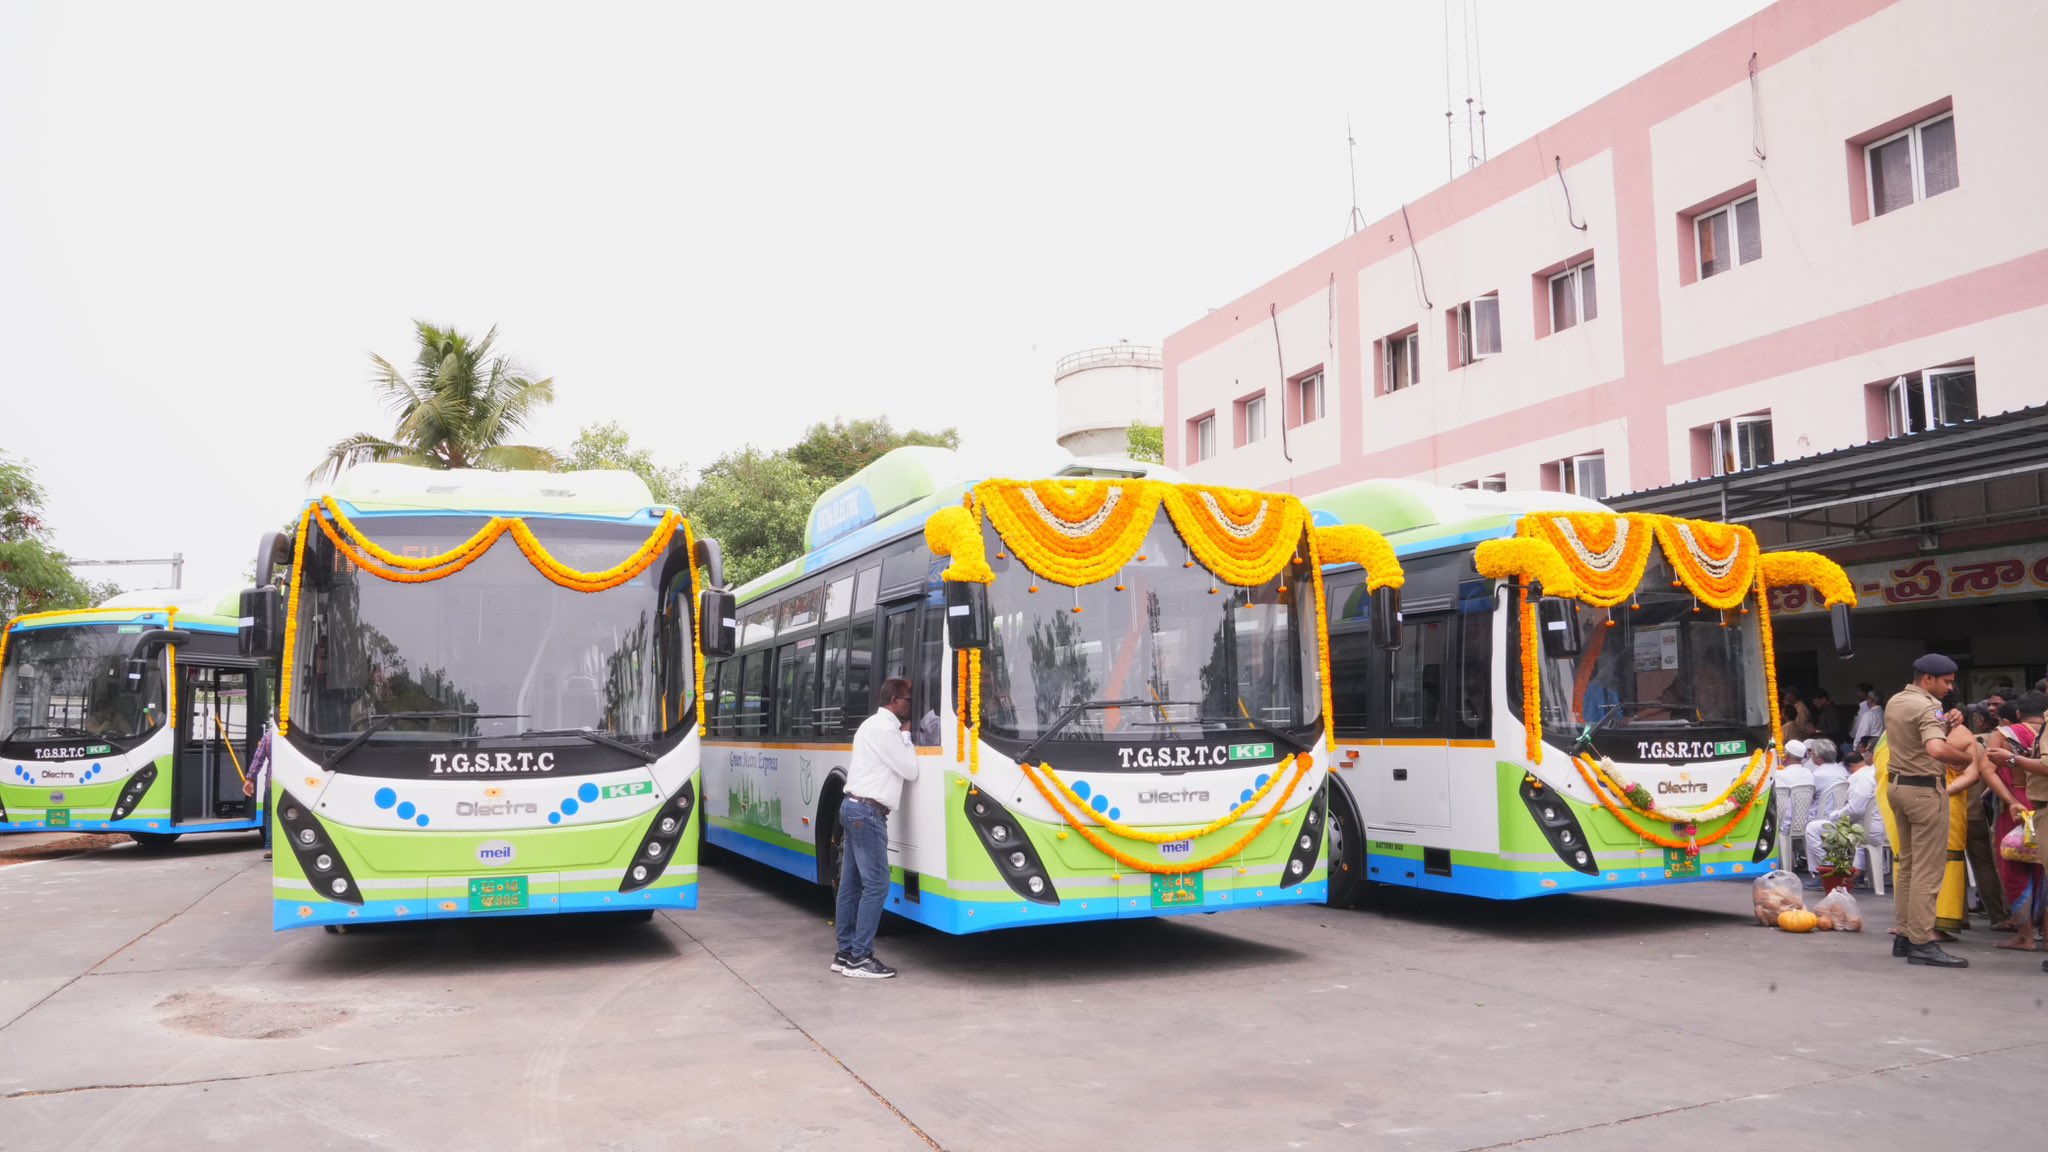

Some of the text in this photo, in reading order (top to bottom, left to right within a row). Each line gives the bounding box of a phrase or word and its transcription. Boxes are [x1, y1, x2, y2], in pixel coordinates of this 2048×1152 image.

[35, 747, 85, 759] T.G.S.R.T.C
[90, 745, 107, 754] KP
[1236, 745, 1266, 758] KP
[1637, 741, 1714, 759] T.G.S.R.T.C
[1720, 742, 1741, 753] KP
[430, 752, 555, 773] T.G.S.R.T.C
[1118, 745, 1227, 768] T.G.S.R.T.C
[758, 752, 779, 776] Express
[41, 770, 75, 779] Olectra
[609, 783, 646, 798] KP
[1658, 780, 1708, 794] Olectra
[50, 793, 64, 801] meil
[1138, 787, 1210, 804] Olectra
[456, 800, 538, 817] Olectra
[480, 846, 511, 858] meil
[1162, 840, 1189, 853] meil
